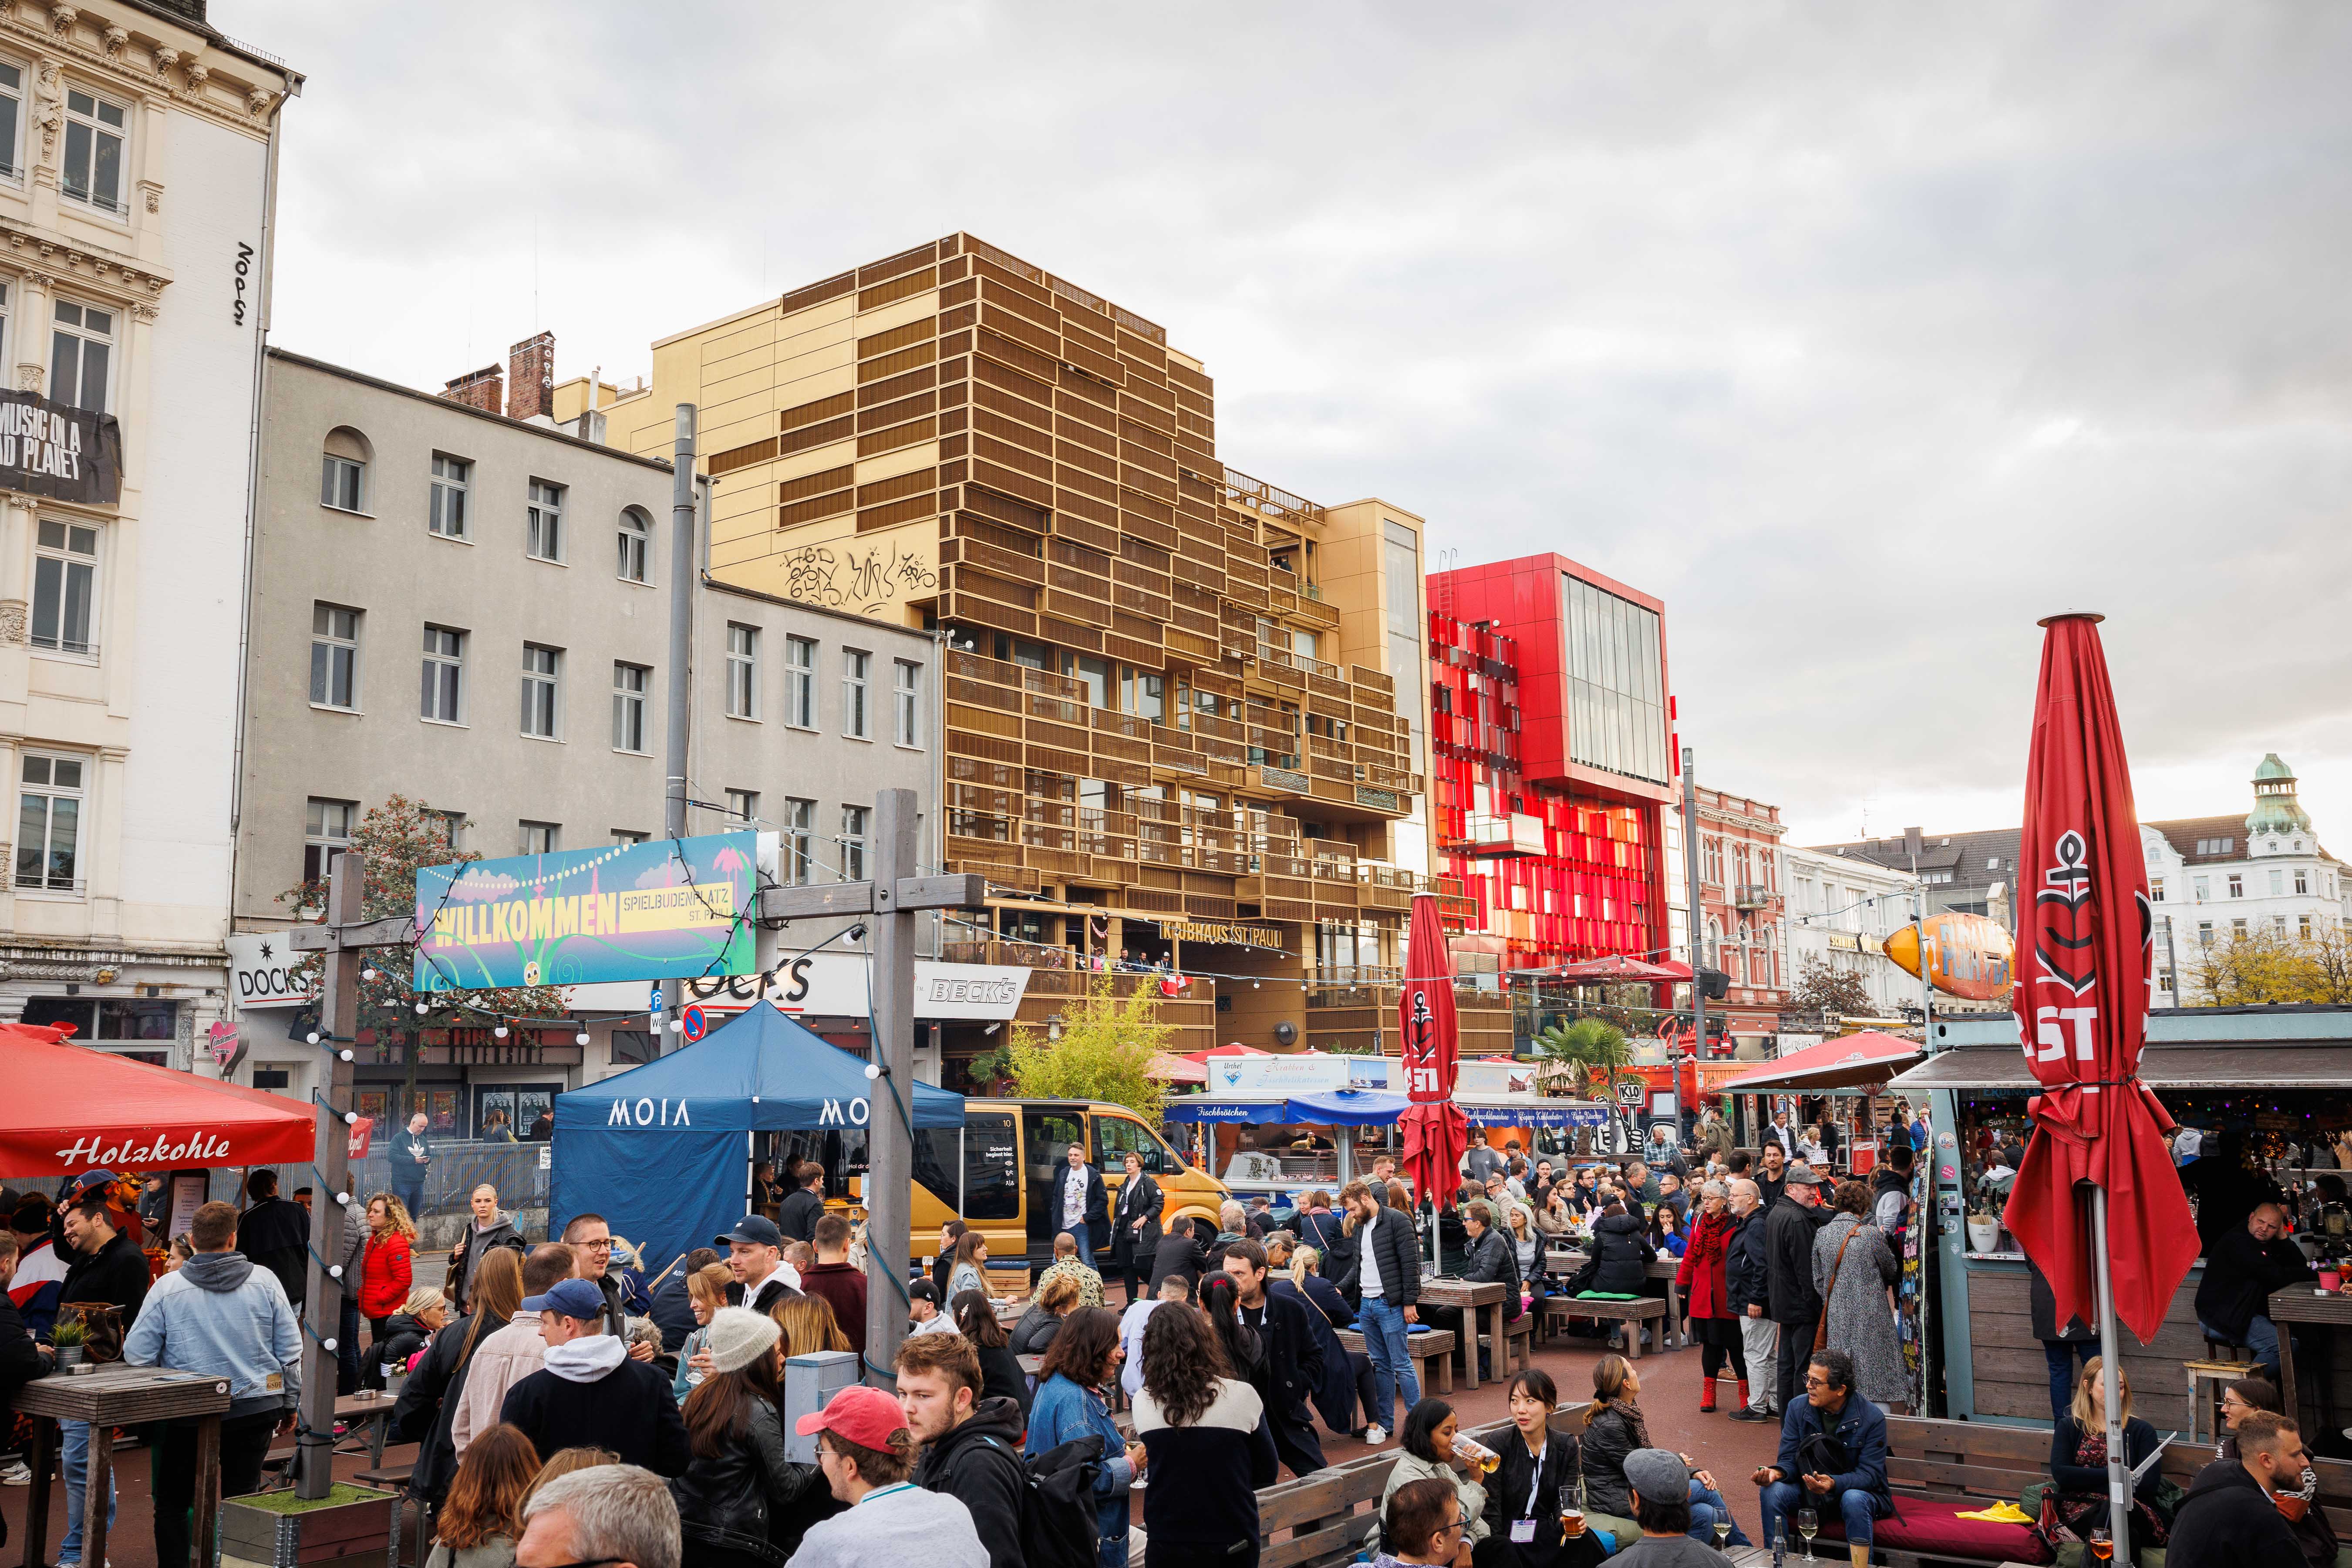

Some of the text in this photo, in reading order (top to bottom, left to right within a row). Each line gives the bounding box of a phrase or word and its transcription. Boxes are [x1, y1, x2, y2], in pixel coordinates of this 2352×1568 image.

[70, 422, 81, 453] A
[623, 888, 728, 911] SPIELBUDENPLATZ
[433, 892, 617, 948] WILLKOMMEN
[689, 910, 701, 921] ST.
[1250, 927, 1282, 948] PAULI
[928, 978, 1016, 1004] BECK'S
[655, 996, 661, 1009] P
[1265, 1062, 1304, 1072] Krabben
[608, 1098, 690, 1126] MOIA
[1196, 1106, 1249, 1117] Fischbrötchen
[1988, 1119, 2007, 1127] Susy
[56, 1131, 229, 1166] Holzkohle
